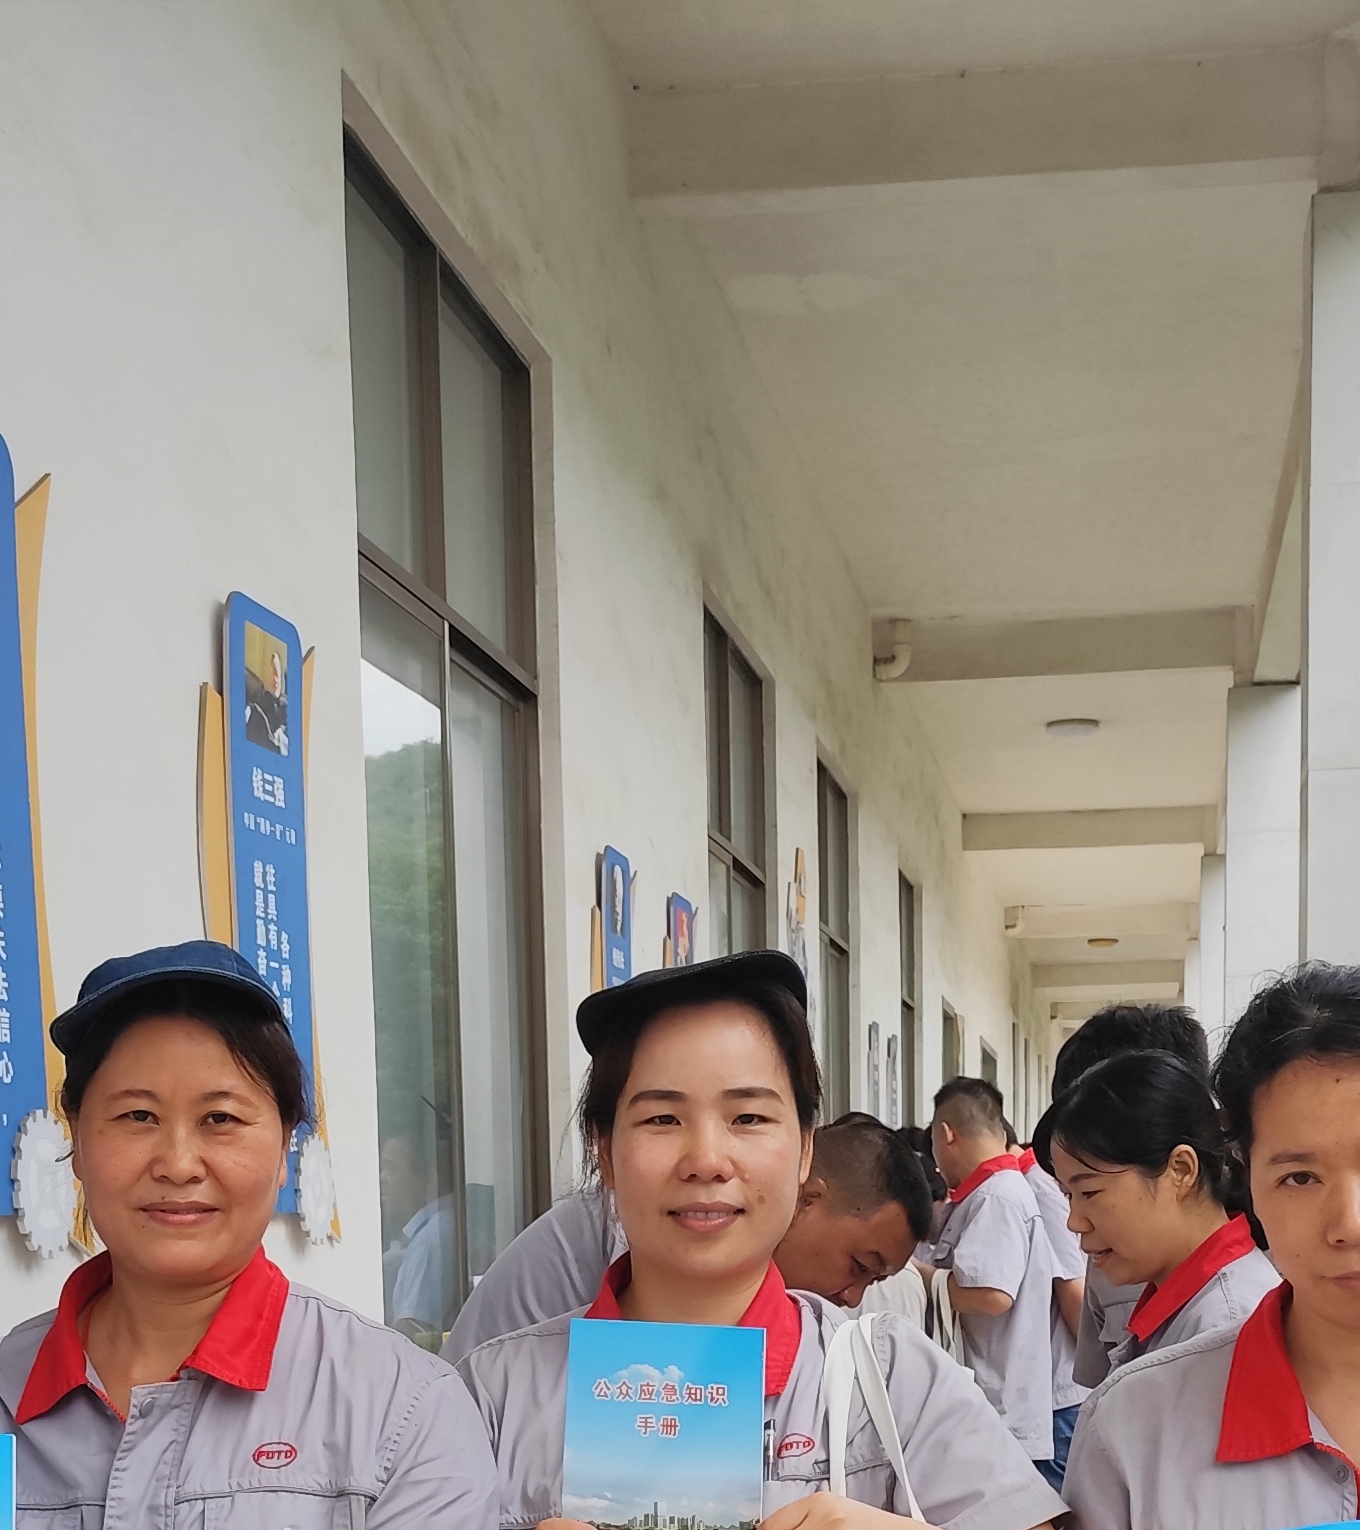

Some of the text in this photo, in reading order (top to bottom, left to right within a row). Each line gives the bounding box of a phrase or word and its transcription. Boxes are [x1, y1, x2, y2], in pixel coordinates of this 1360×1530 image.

[252, 766, 286, 809] 钱三强
[592, 1378, 729, 1405] 公众应急知识
[634, 1414, 681, 1438] 手册
